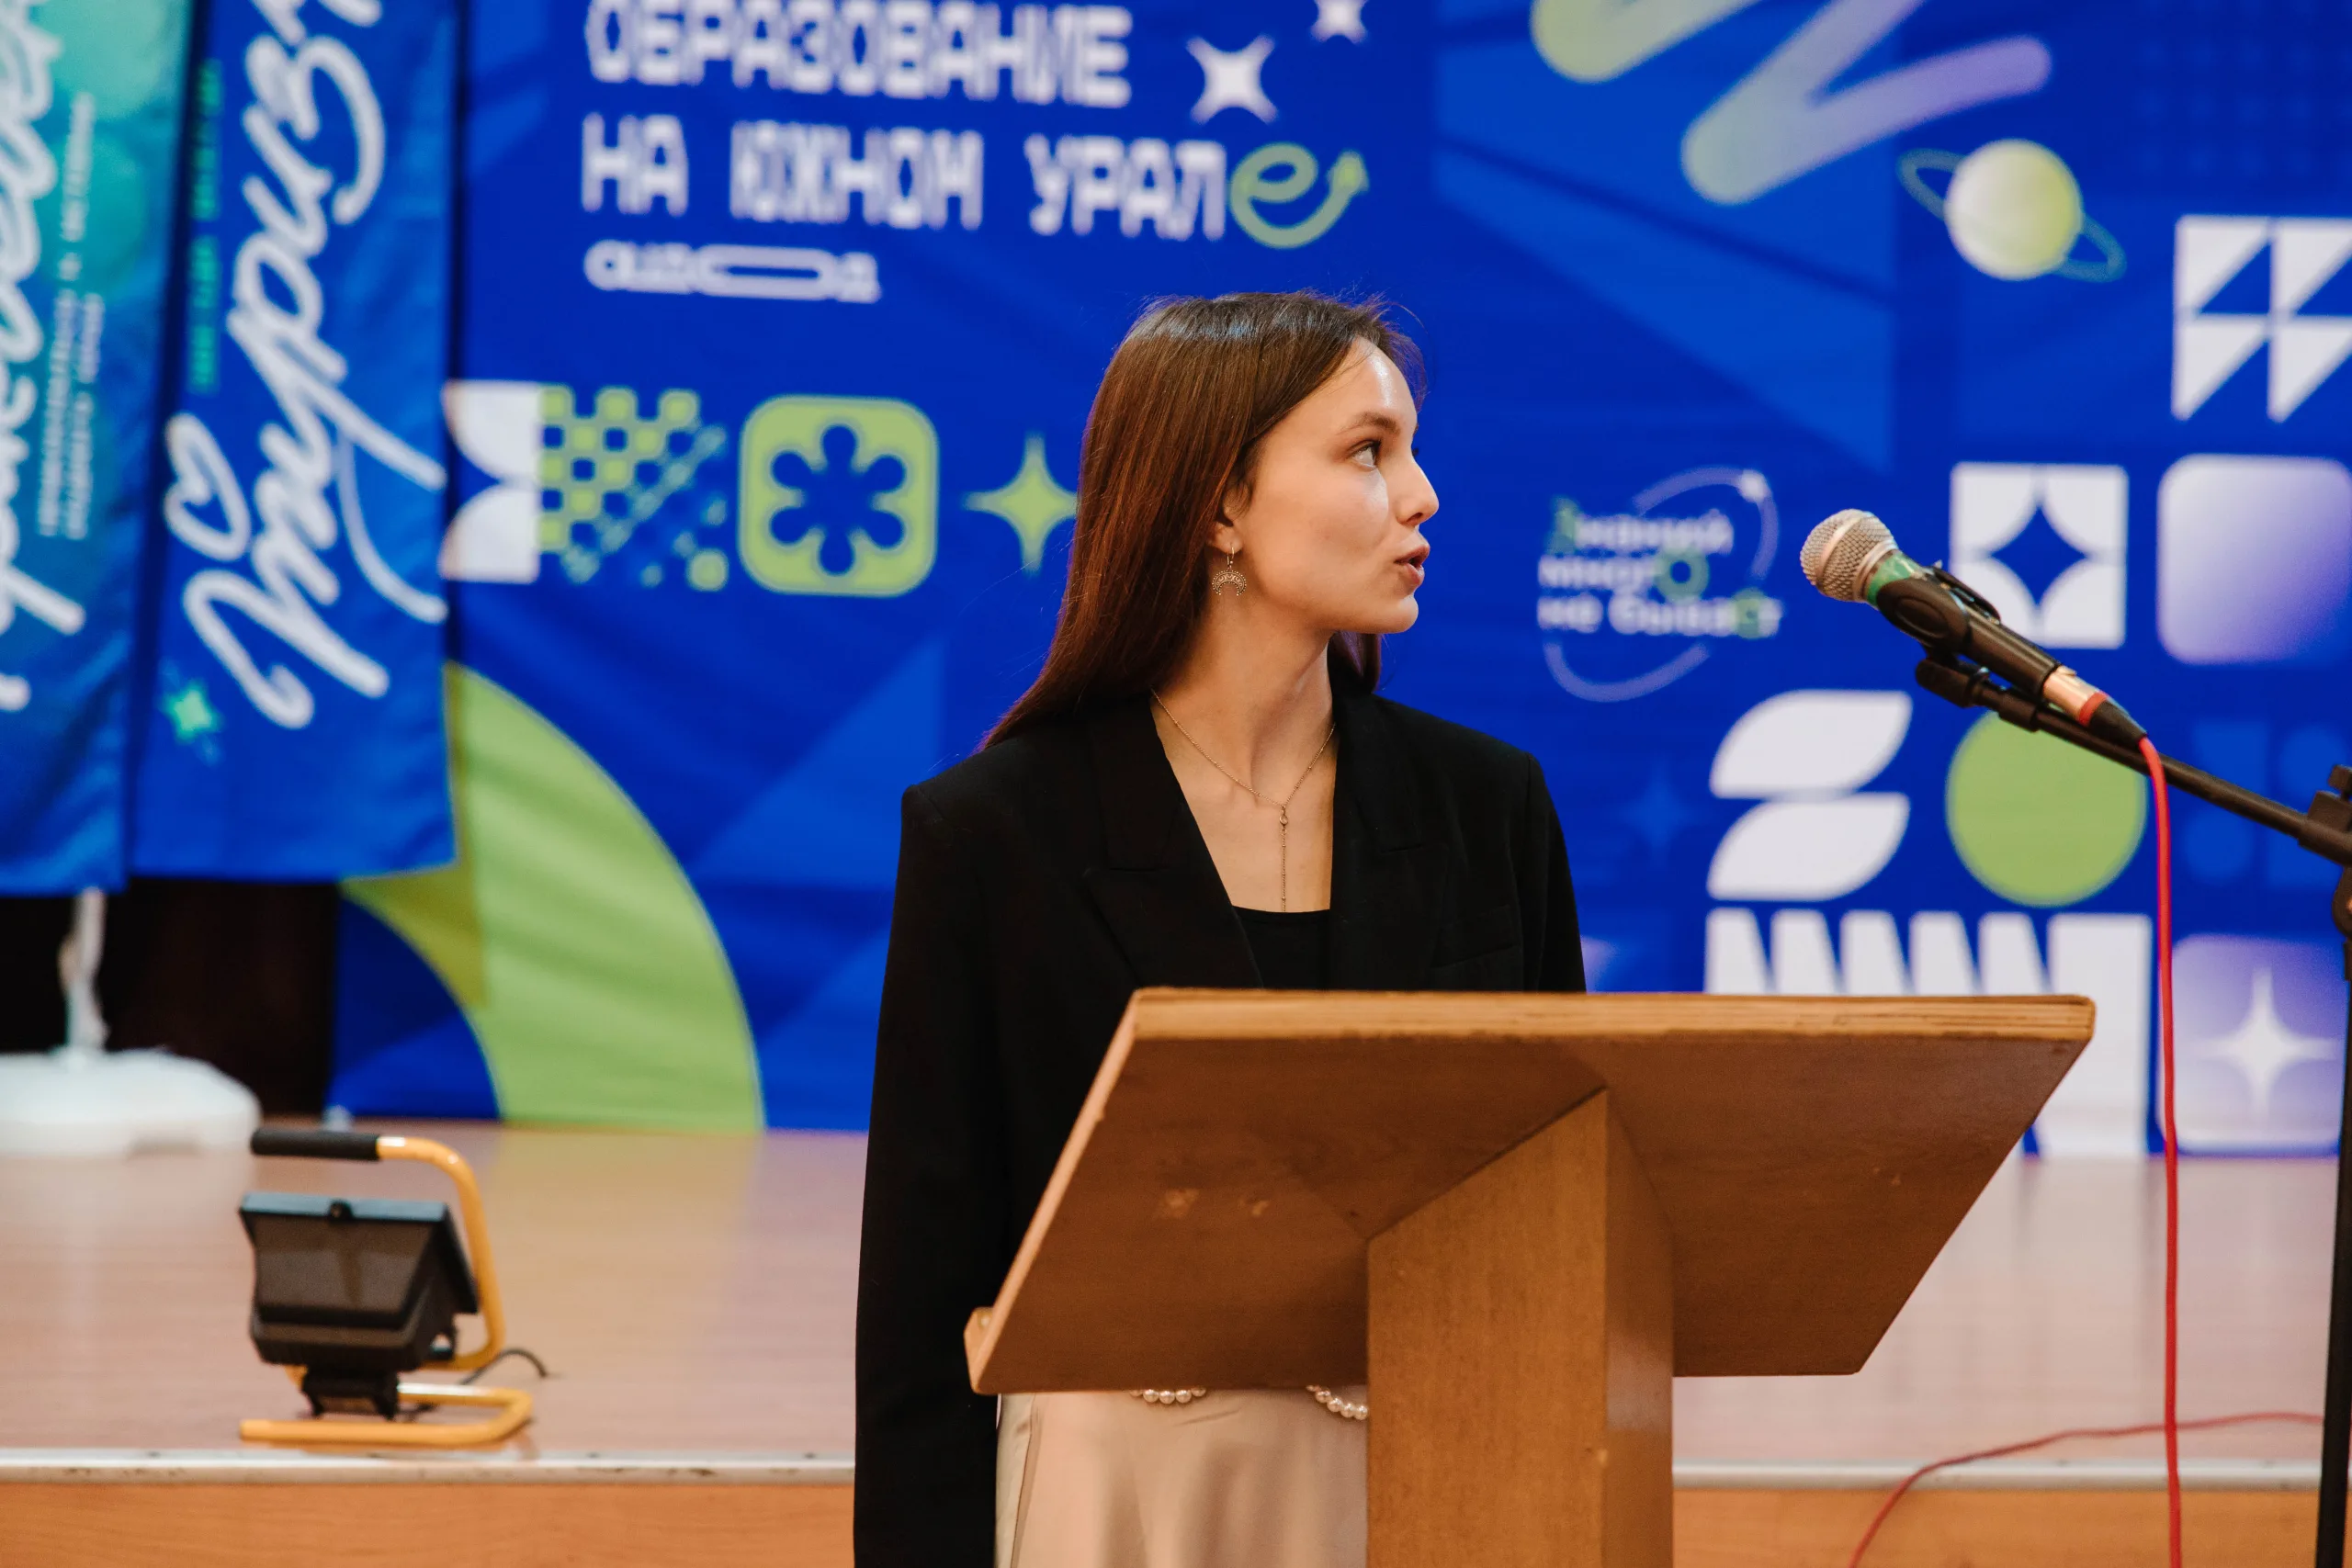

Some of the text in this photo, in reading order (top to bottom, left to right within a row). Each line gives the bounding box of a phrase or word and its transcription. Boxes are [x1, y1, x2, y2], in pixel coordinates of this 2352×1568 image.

[584, 0, 1133, 107] ОБРАЗОВАНИЕ
[582, 112, 689, 215] НА
[730, 121, 985, 230] ЮЖНОМ
